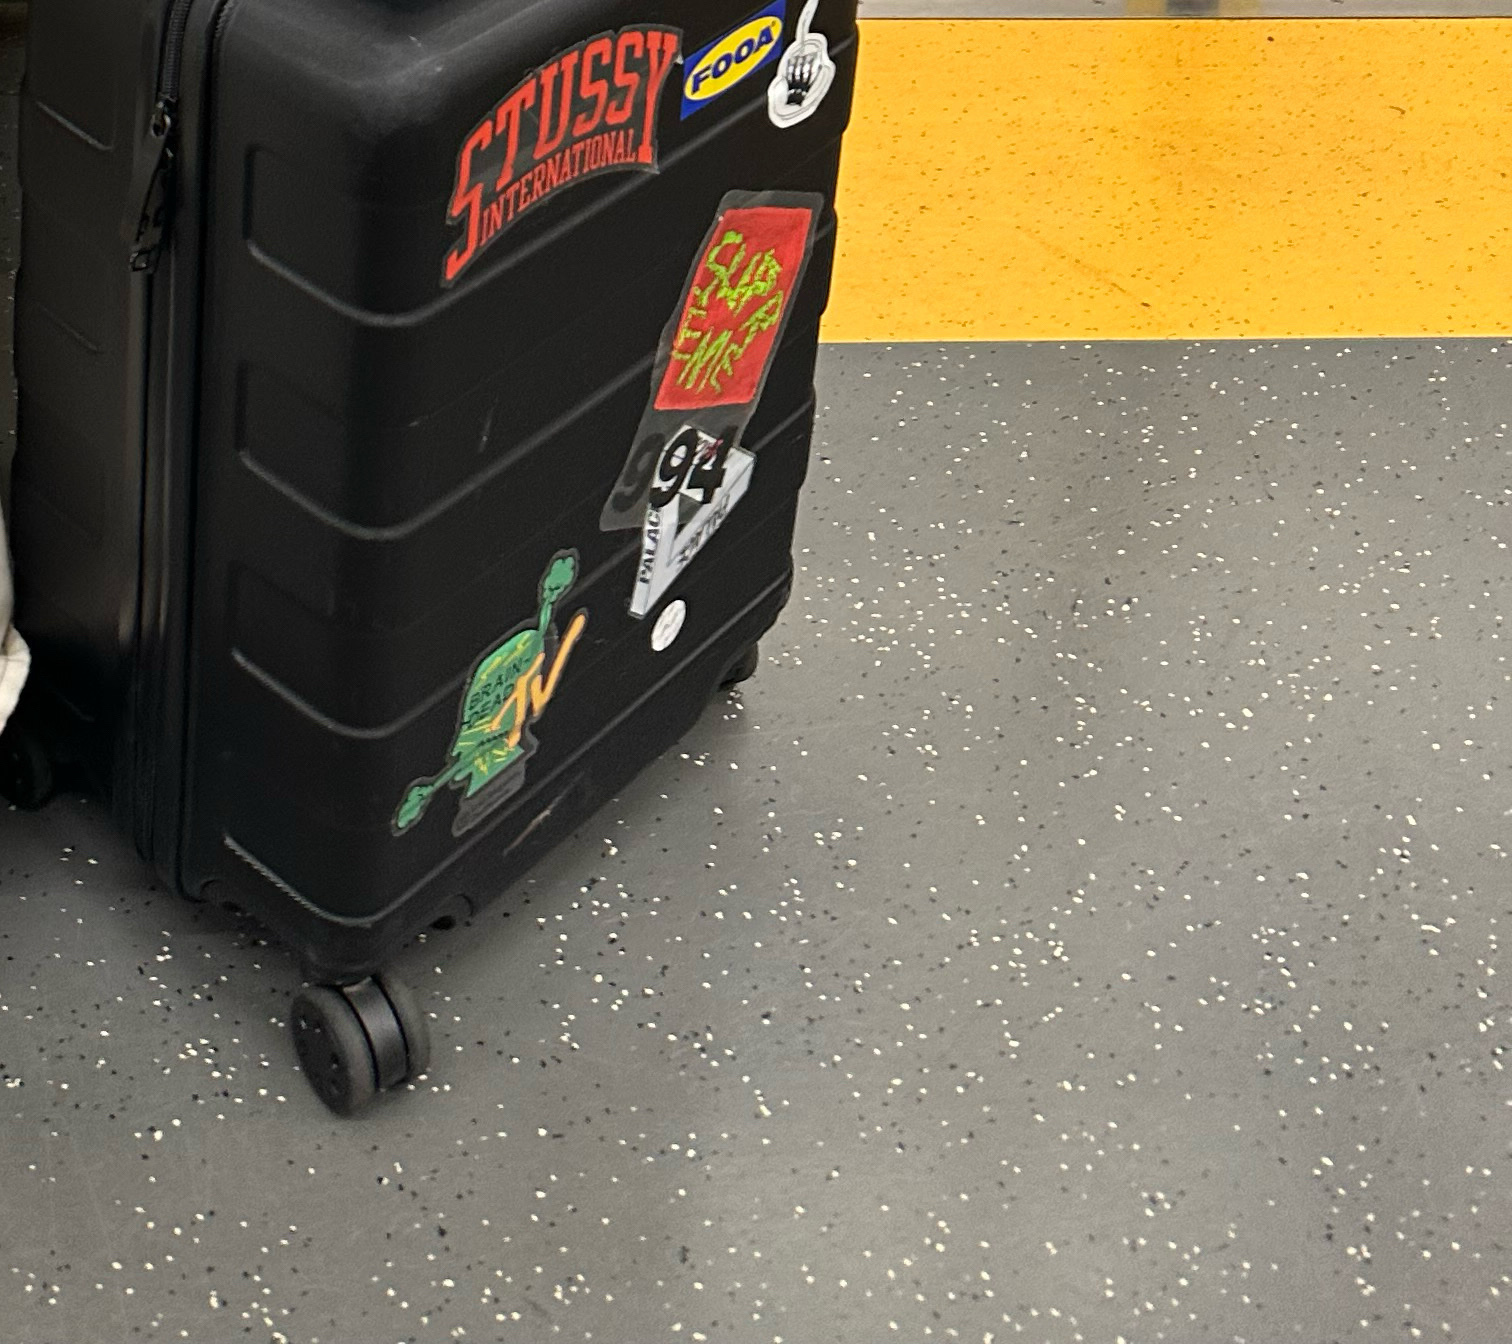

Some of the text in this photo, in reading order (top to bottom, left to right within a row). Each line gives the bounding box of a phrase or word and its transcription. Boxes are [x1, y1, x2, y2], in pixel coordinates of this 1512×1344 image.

[691, 28, 775, 96] FOOA
[444, 30, 679, 280] STUSSY
[480, 128, 637, 247] INTERNATIONAL
